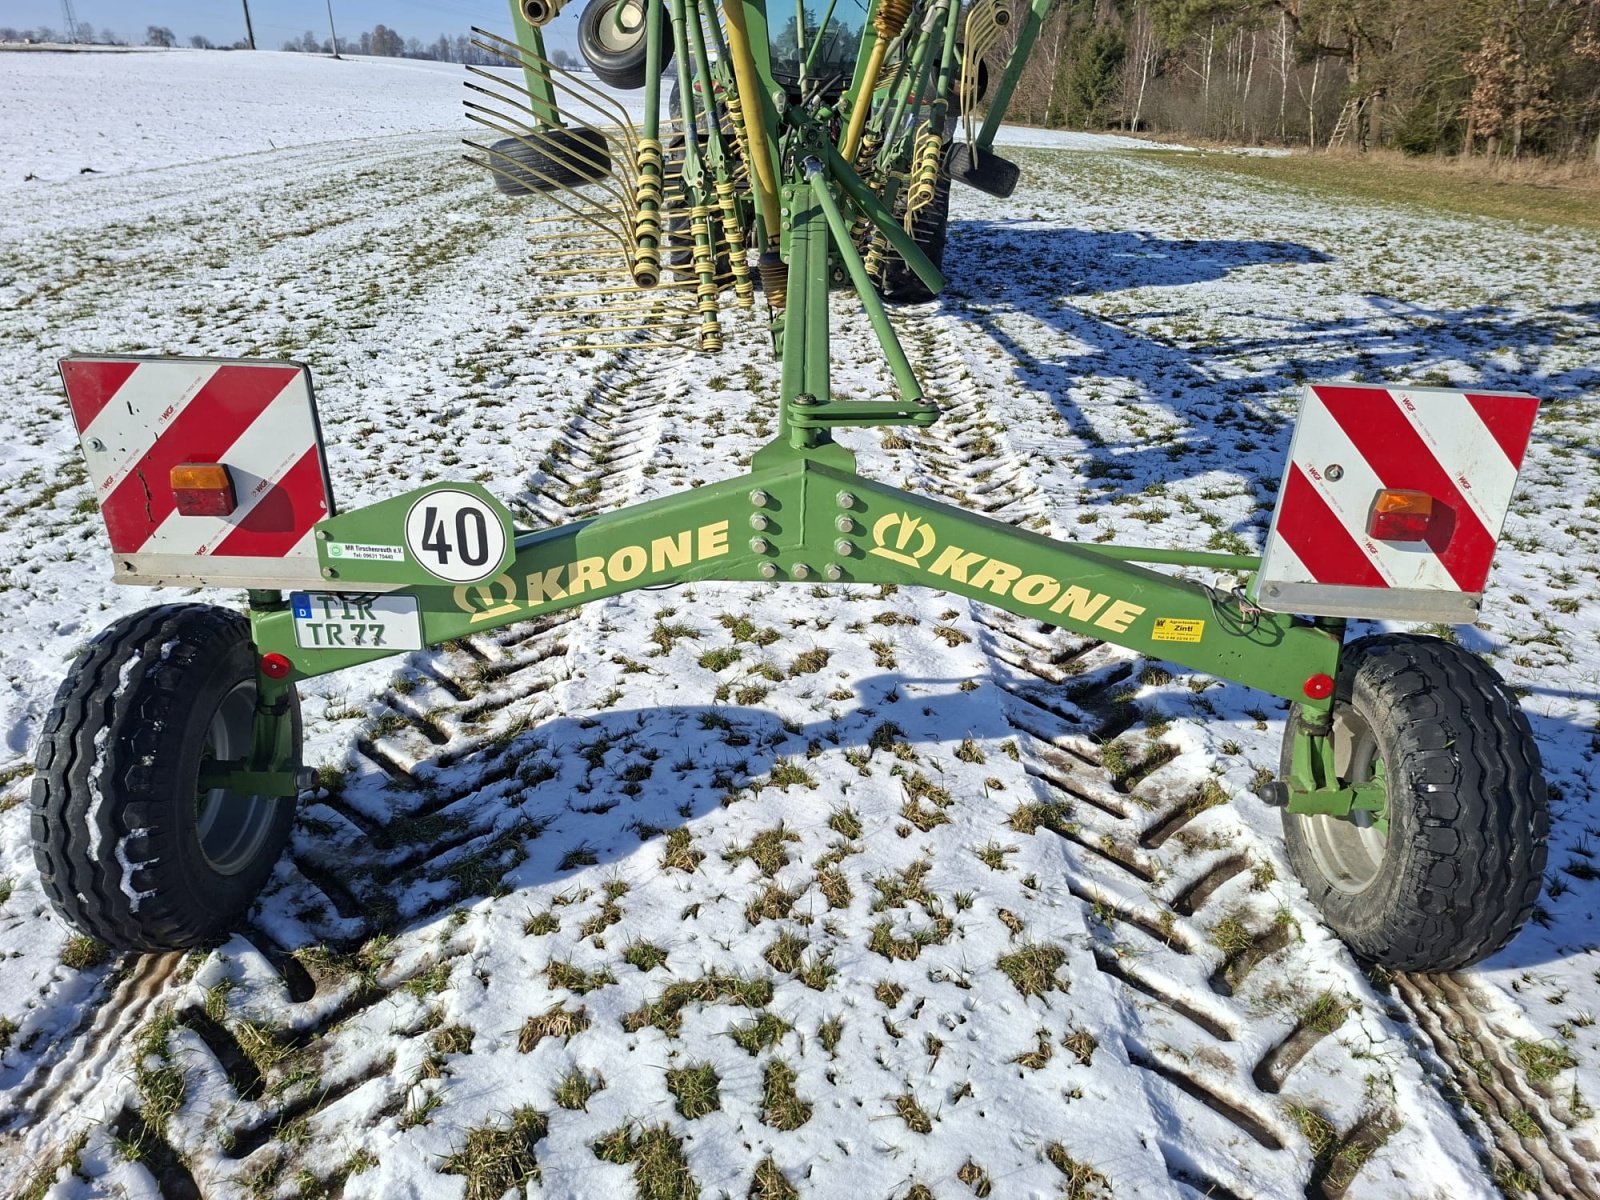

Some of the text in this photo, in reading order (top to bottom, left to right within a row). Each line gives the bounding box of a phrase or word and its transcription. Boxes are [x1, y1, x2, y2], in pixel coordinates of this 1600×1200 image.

[421, 506, 489, 567] 40
[525, 519, 729, 608] KRONE
[299, 608, 307, 617] D
[316, 596, 377, 620] TIR
[927, 545, 1147, 633] KRONE
